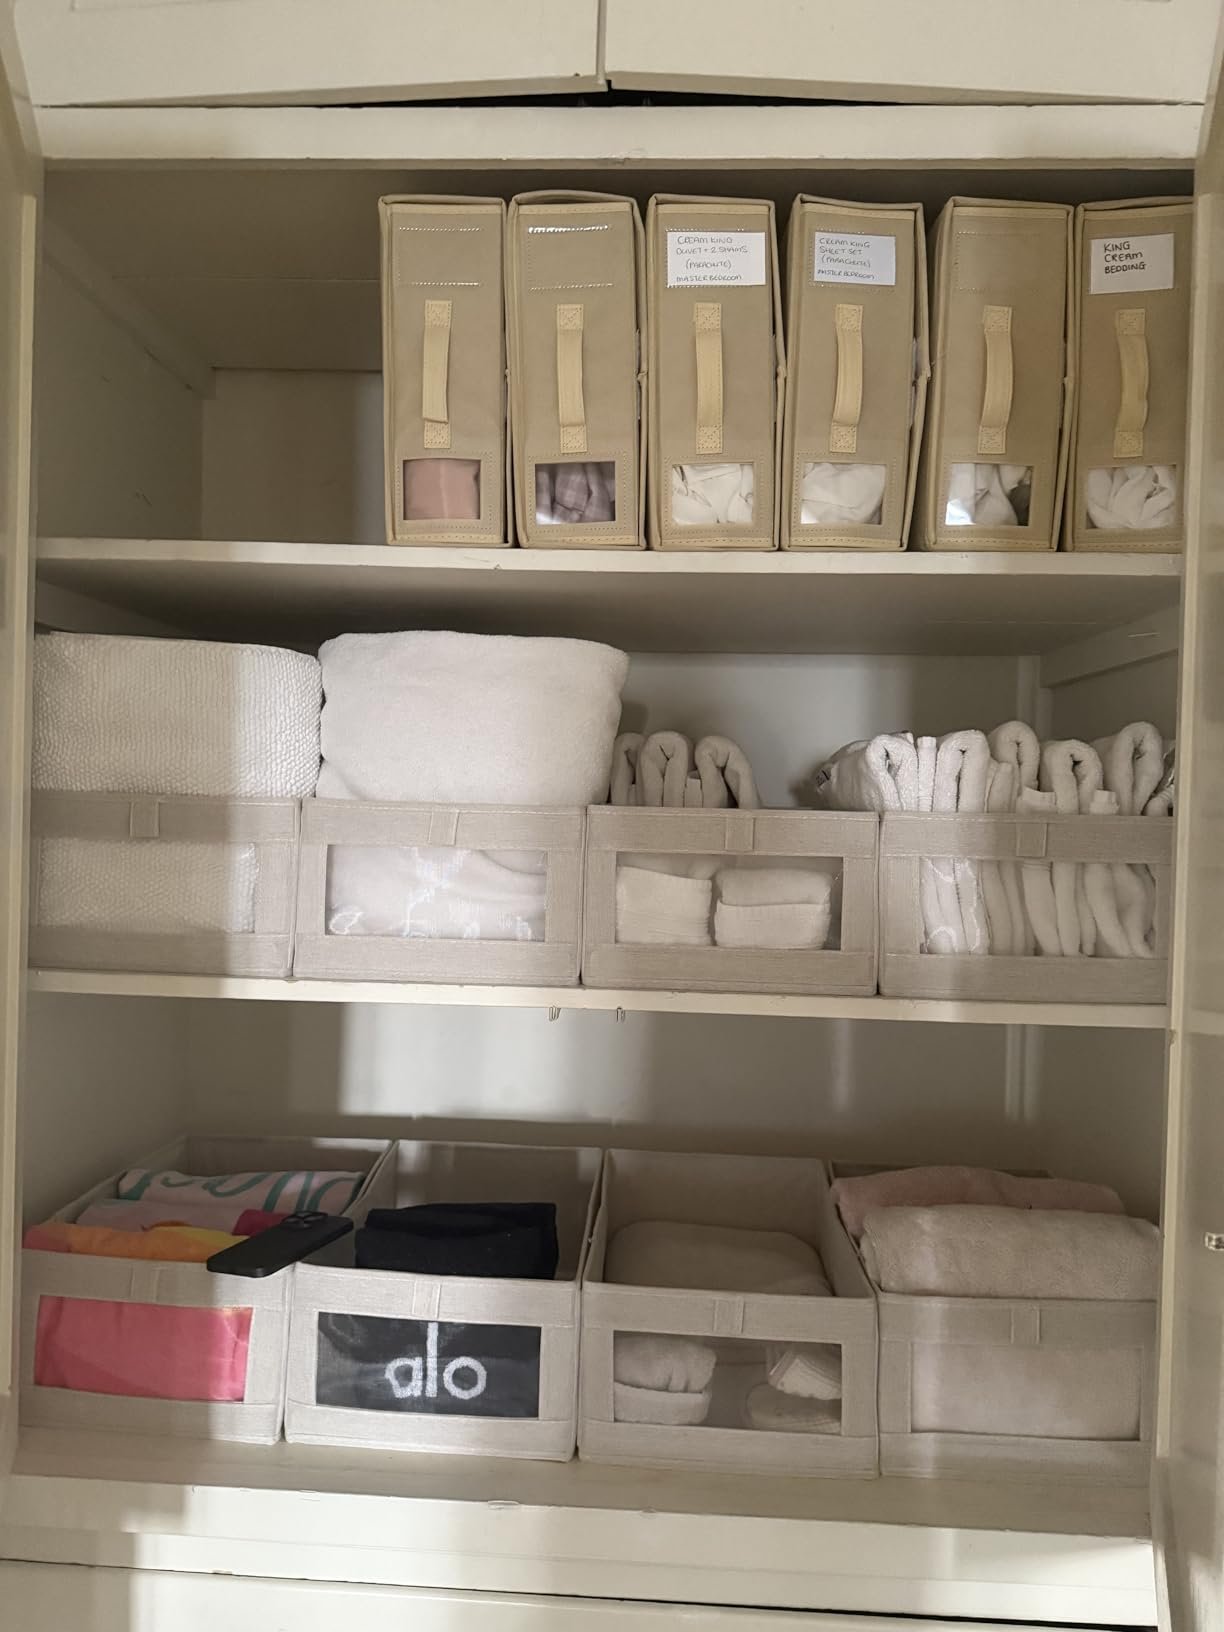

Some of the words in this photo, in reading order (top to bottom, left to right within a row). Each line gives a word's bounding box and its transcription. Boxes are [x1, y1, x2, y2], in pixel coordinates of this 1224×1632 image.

[677, 235, 708, 244] CREAM
[819, 237, 848, 246] CREAM
[850, 241, 871, 249] KING
[819, 246, 846, 255] SHEET
[1104, 241, 1130, 253] KING
[1104, 251, 1143, 263] CREAM
[1104, 262, 1147, 274] BEDDING
[385, 1321, 487, 1400] alo
